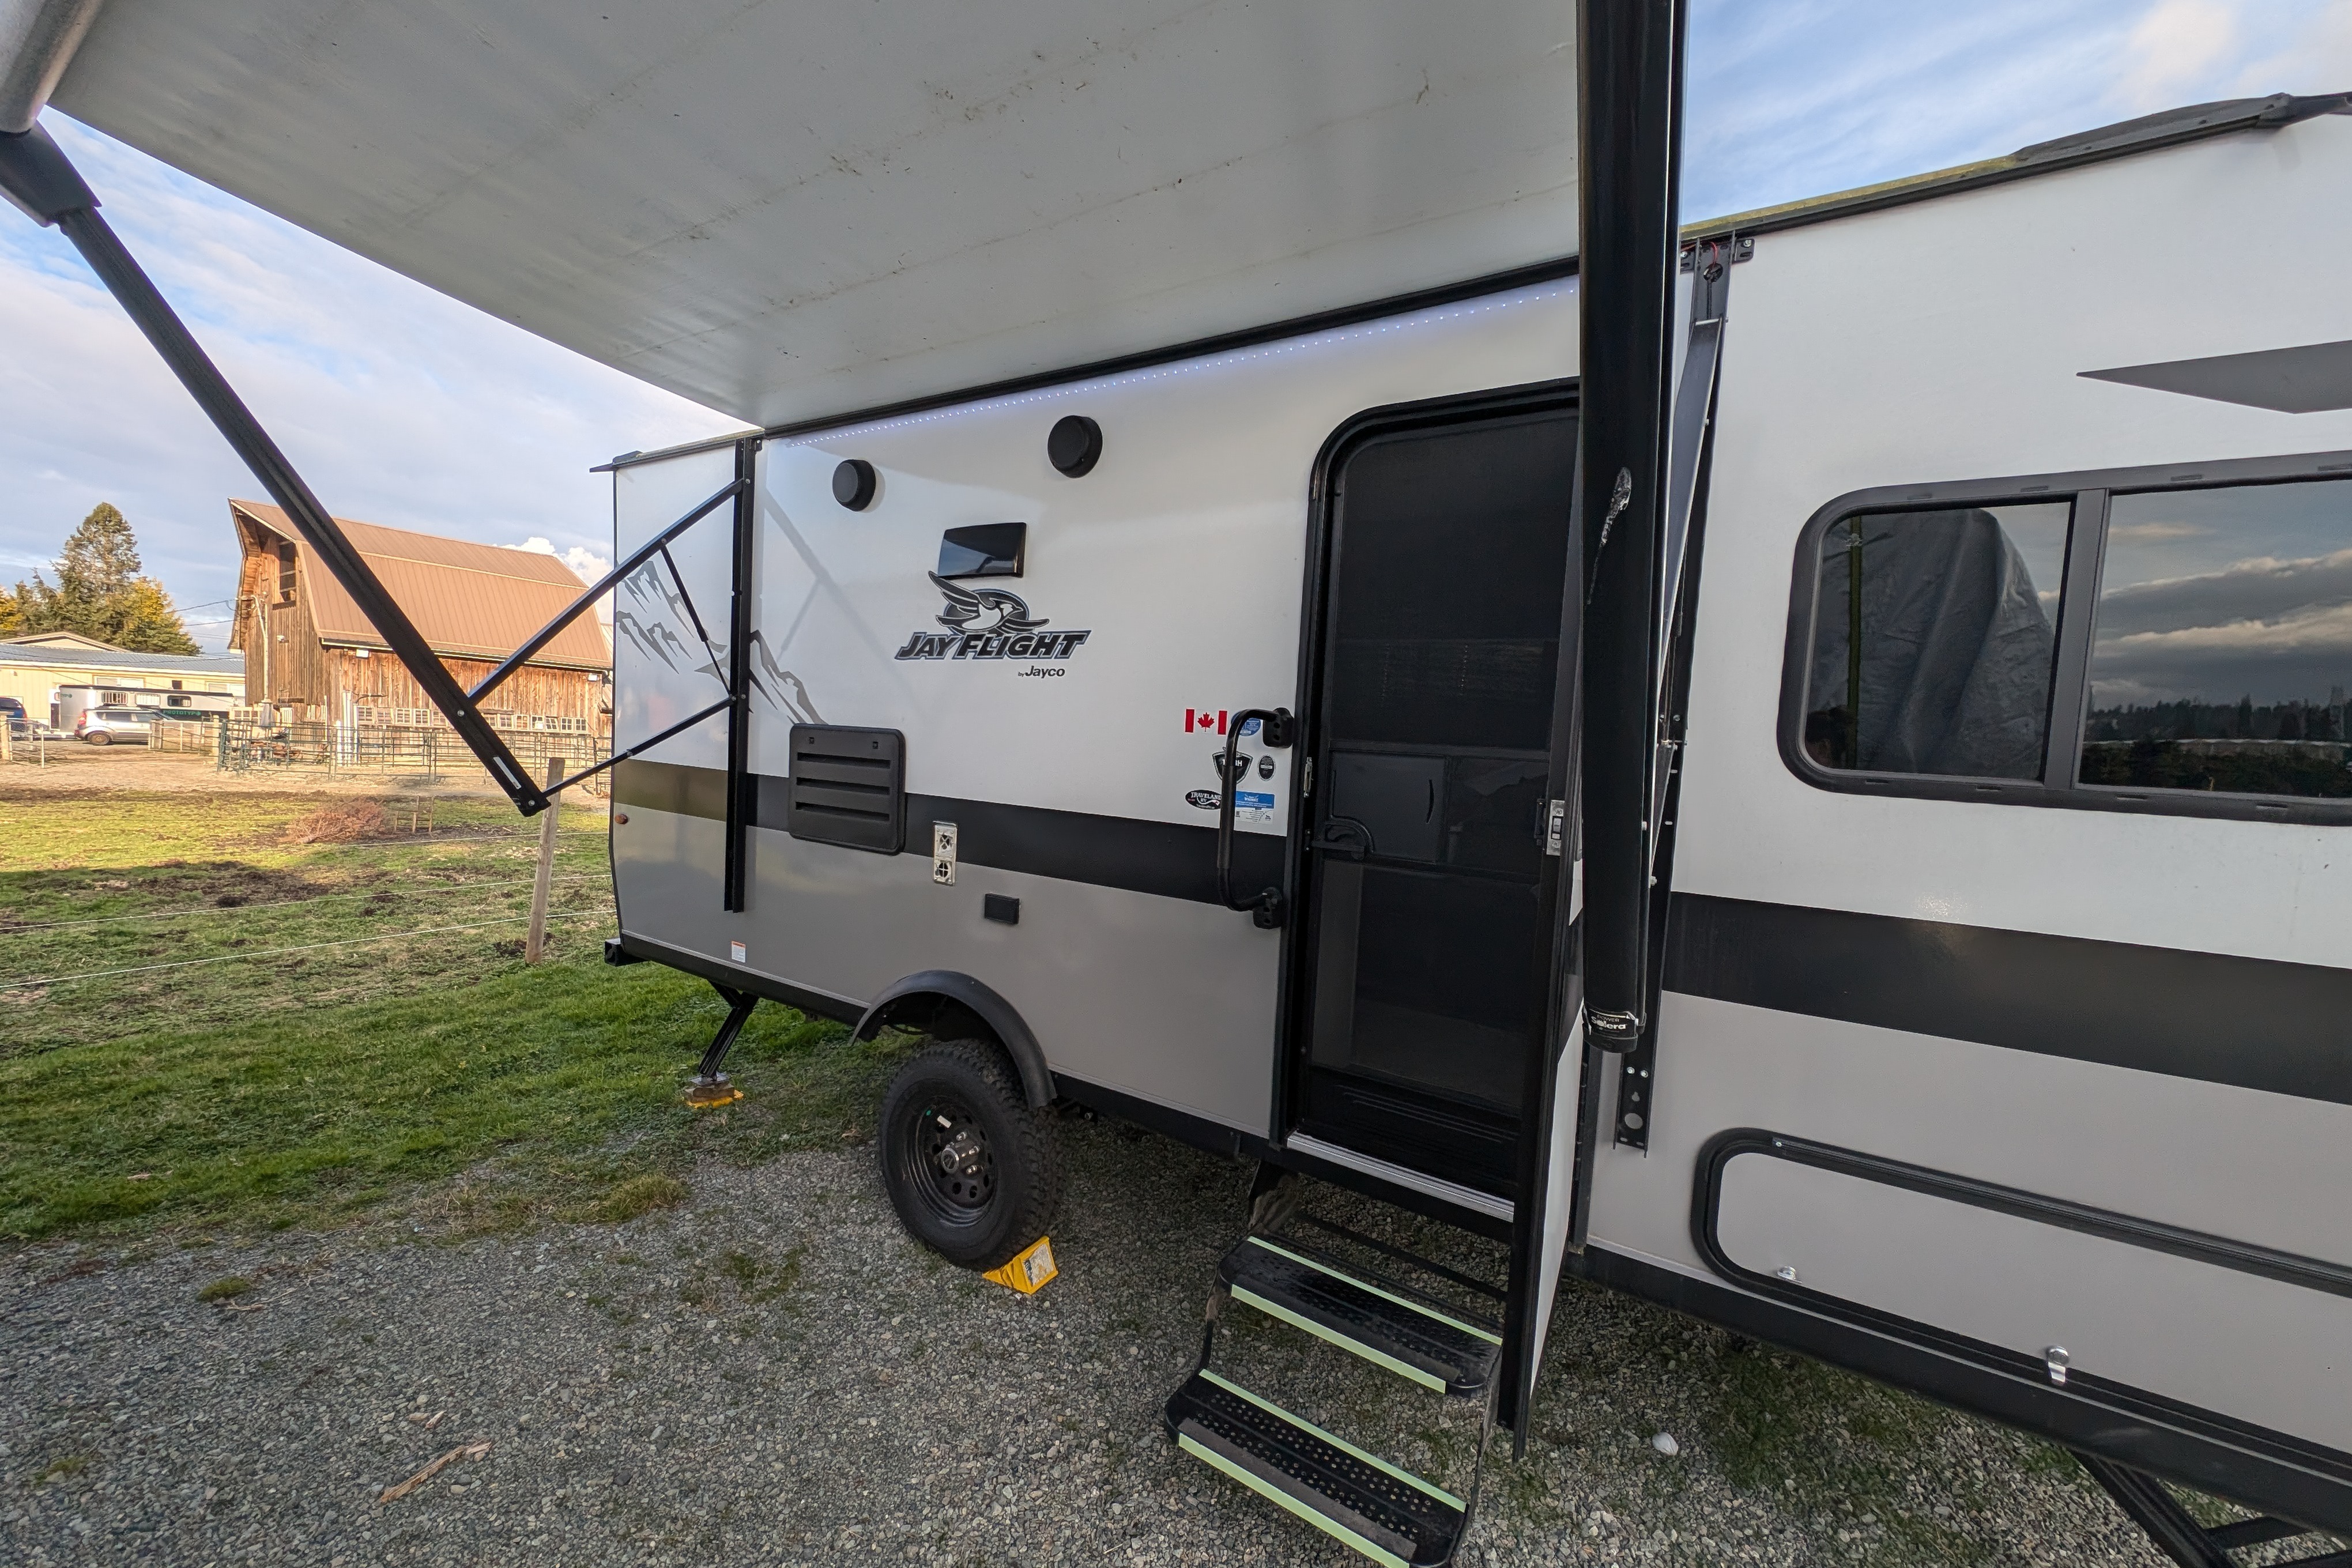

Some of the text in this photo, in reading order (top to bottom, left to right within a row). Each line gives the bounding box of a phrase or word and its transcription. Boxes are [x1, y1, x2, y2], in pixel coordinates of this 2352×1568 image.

[895, 631, 1091, 659] JAY FLIGHT
[1025, 665, 1065, 679] Jayco
[1191, 791, 1222, 800] TRAVELAND
[1591, 1016, 1626, 1030] Solera
